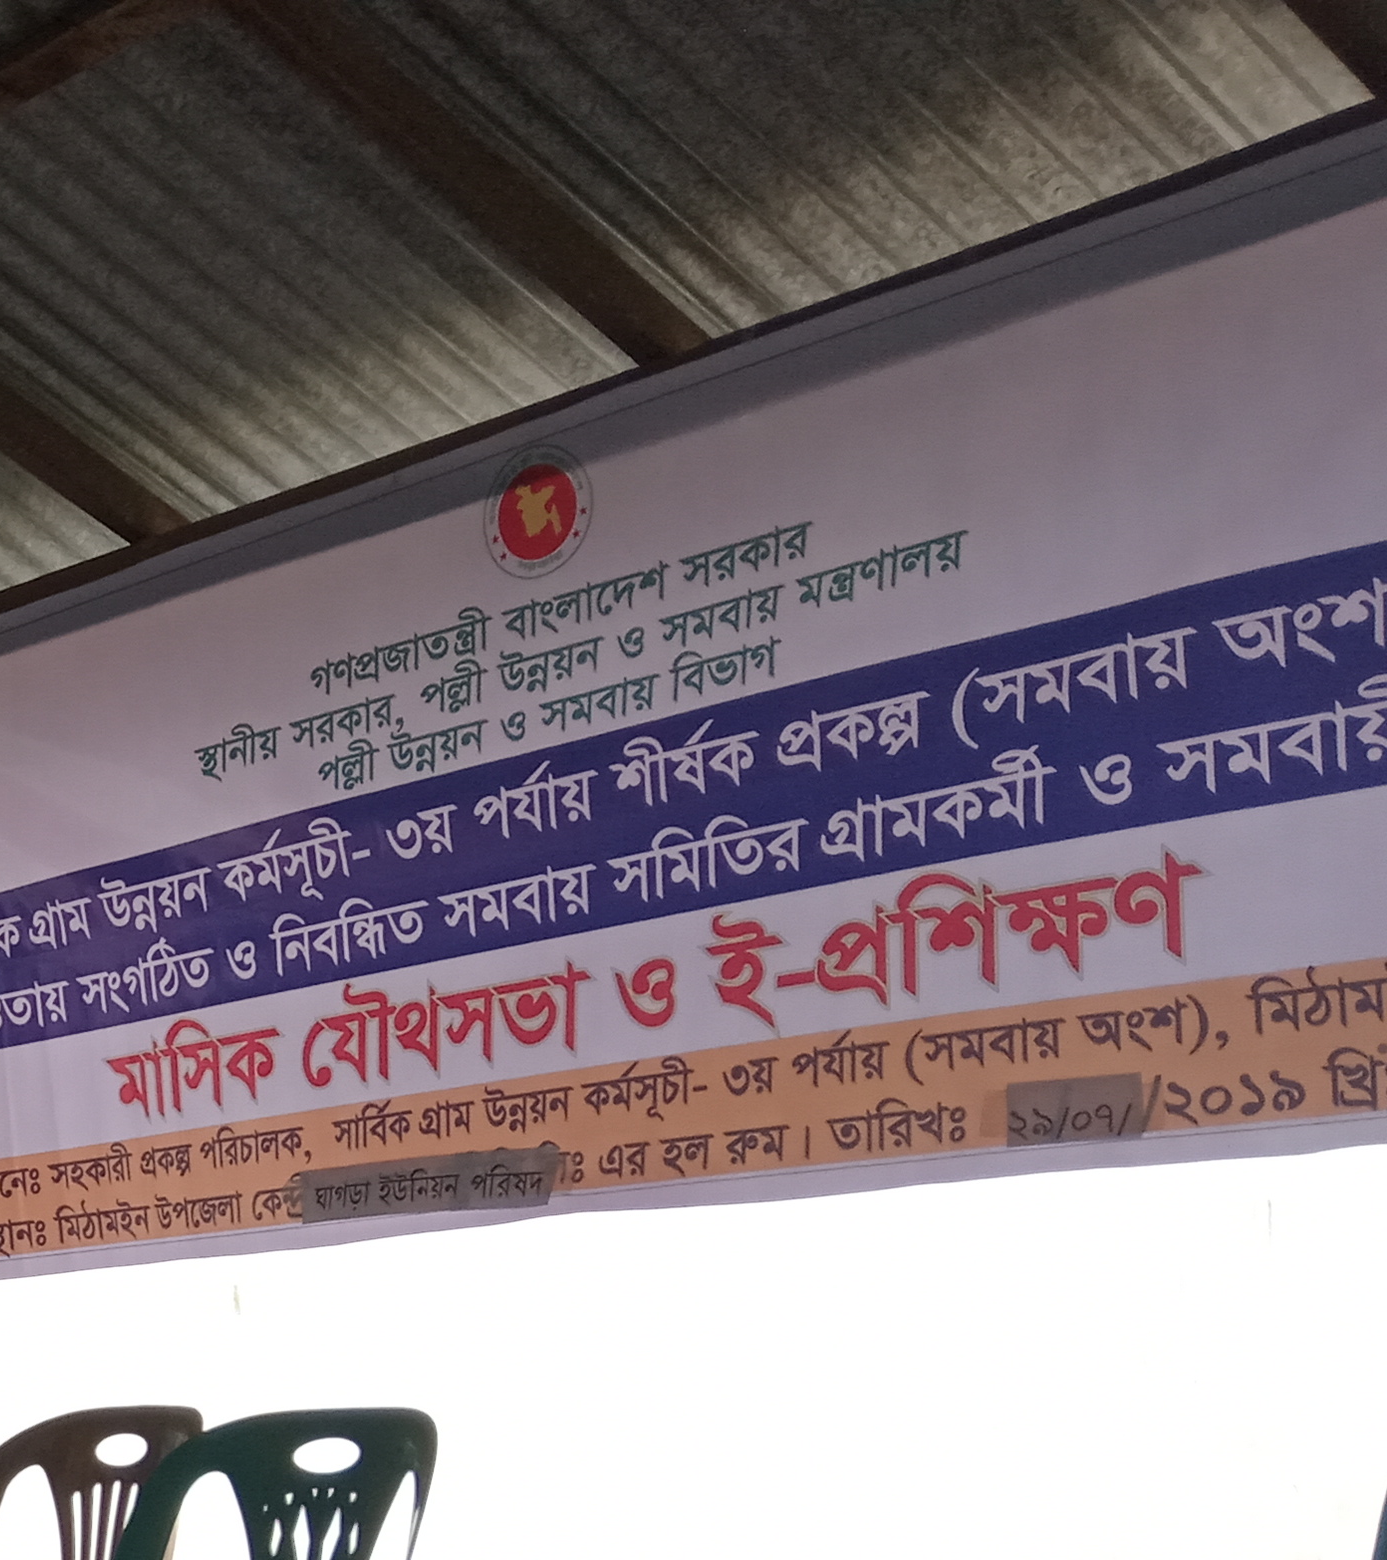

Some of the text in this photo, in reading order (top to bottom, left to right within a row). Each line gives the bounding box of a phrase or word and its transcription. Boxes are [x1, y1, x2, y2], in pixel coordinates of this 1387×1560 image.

[194, 530, 968, 781] স্থানীয় সরকার, পল্লী উন্নয়ন ও সমবায় মন্ত্রণালয়
[503, 561, 668, 639] বাংলাদেশ
[681, 522, 812, 586] সরকার
[28, 893, 91, 951] গ্রাম
[99, 876, 210, 932] উন্নয়ন
[385, 803, 455, 861] ৩য়
[474, 762, 597, 841] পর্যায়
[611, 720, 759, 806] শীর্ষক
[776, 691, 931, 769] প্রকল্প
[951, 626, 1196, 749] (সমবায়
[318, 637, 781, 791] পল্লী উন্নয়ন ও সমবায় বিভাগ
[78, 935, 210, 1016] সংগঠিত
[227, 944, 257, 980] ও
[269, 896, 430, 975] নিবন্ধিত
[438, 863, 596, 944] সমবায়
[607, 816, 809, 902] সমিতির
[819, 746, 1057, 863] গ্রামকর্মী
[1079, 755, 1134, 806] ও
[105, 842, 1212, 1121] মাসিক যৌথসভা ও ই-প্রশিক্ষণ
[50, 1144, 132, 1193] সহকারী
[139, 1136, 193, 1180] প্রকল্প
[200, 1120, 313, 1171] পরিচালক,
[333, 1100, 413, 1150] সার্বিক
[417, 1100, 472, 1136] গ্রাম
[482, 1086, 571, 1130] উন্নয়ন
[723, 1061, 776, 1098] ৩য়
[792, 1031, 890, 1086] পর্যায়
[904, 1014, 1067, 1086] (সমবায়
[1077, 994, 1230, 1055] অংশ),
[1245, 965, 1387, 1035] মিঠাম
[57, 1200, 151, 1246] মিঠামইন
[154, 1186, 243, 1231] উপজেলা
[378, 1165, 459, 1205] ইউনিয়ন
[470, 1163, 544, 1199] পরিষদ
[599, 1142, 649, 1178] এর
[662, 1133, 709, 1177] হল
[724, 1122, 786, 1165] রুম
